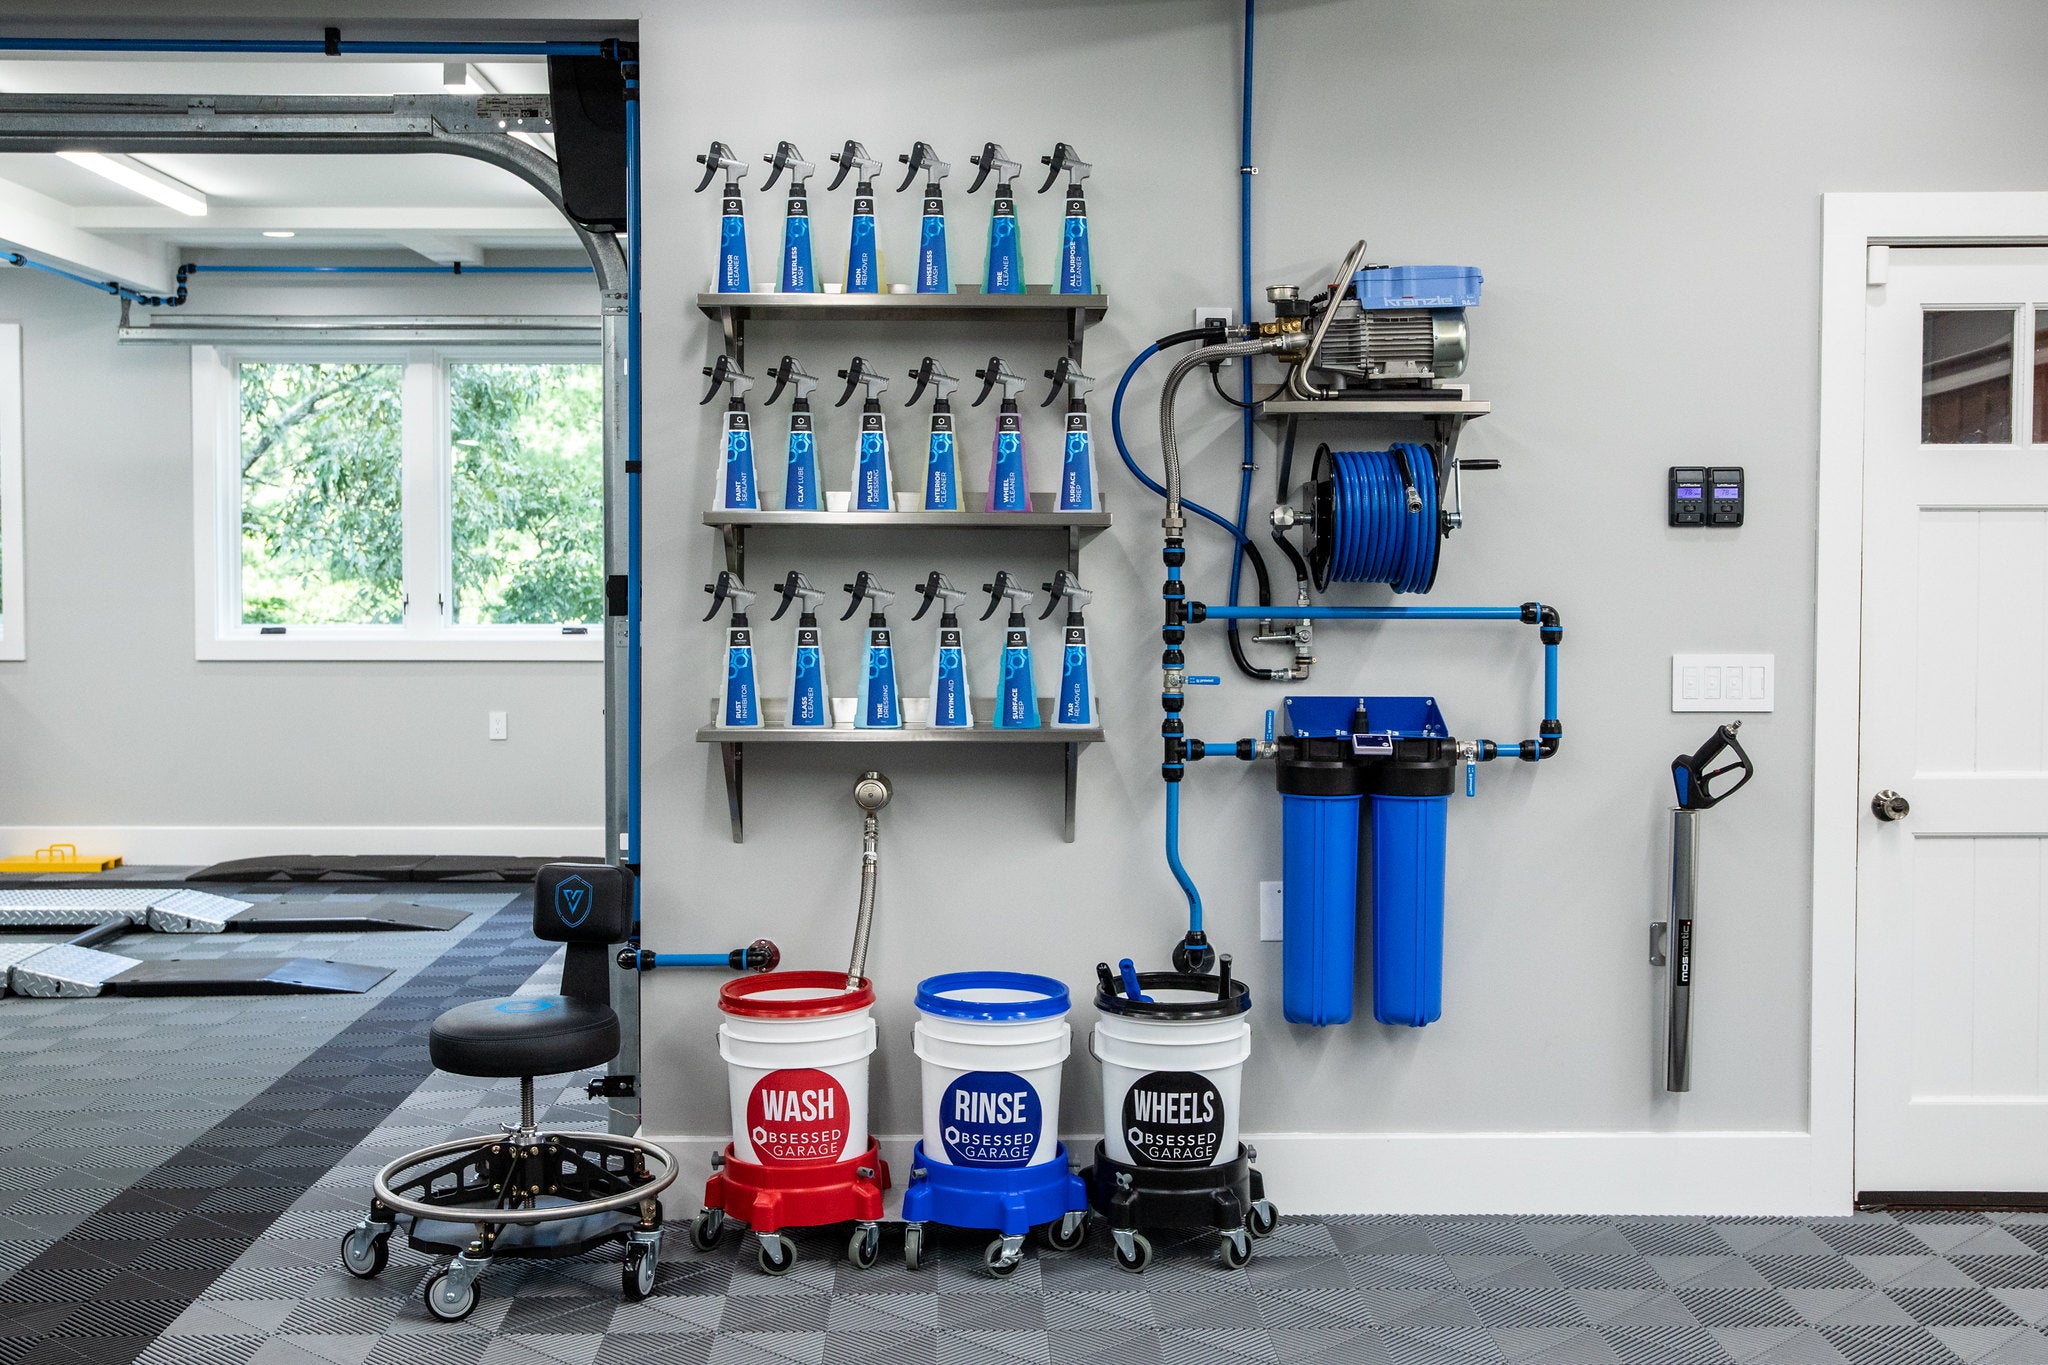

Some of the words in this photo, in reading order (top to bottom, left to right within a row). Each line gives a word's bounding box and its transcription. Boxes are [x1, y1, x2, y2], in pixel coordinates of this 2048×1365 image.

[1681, 925, 1690, 982] mosmatic
[761, 1087, 835, 1122] WASH
[955, 1089, 1028, 1125] RINSE
[1133, 1088, 1215, 1125] WHEELS
[773, 1142, 838, 1157] GARAGE
[965, 1145, 1030, 1159] GARAGE
[1150, 1145, 1214, 1159] GARAGE
